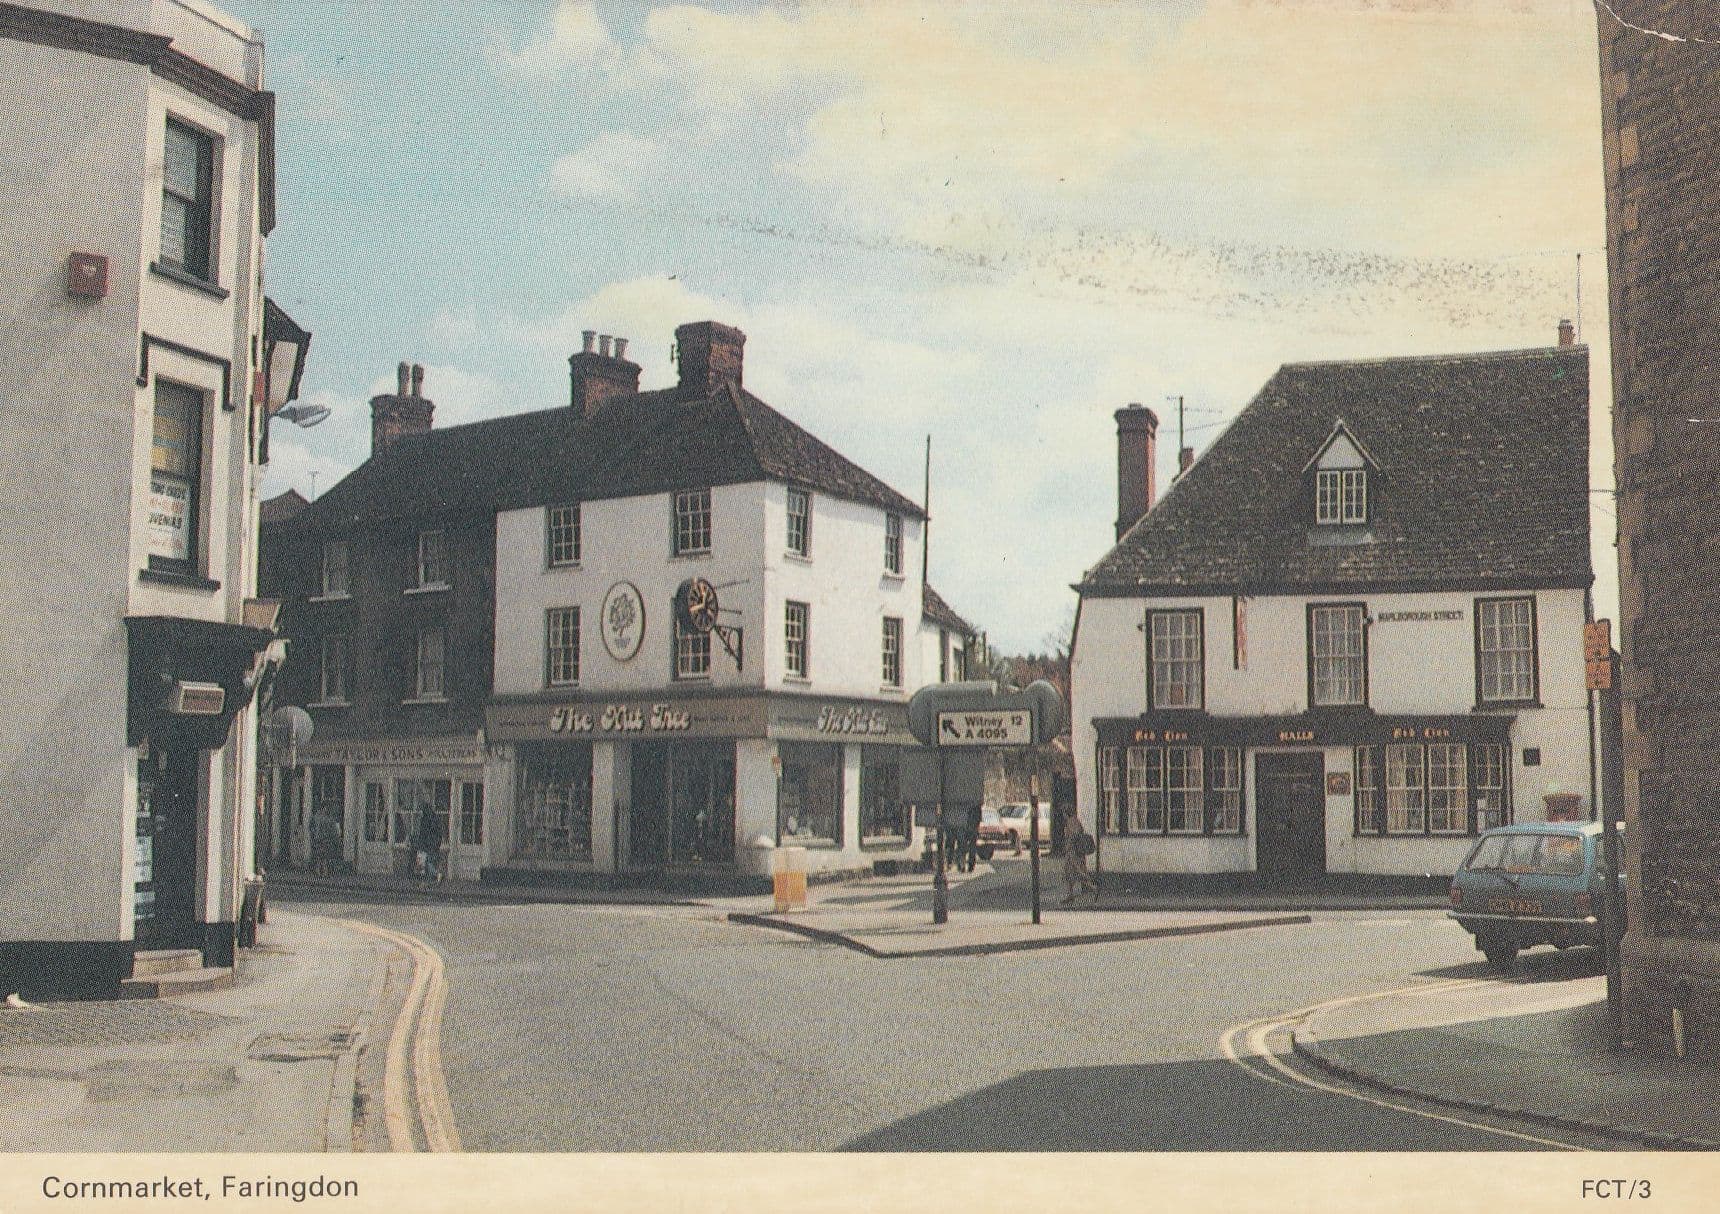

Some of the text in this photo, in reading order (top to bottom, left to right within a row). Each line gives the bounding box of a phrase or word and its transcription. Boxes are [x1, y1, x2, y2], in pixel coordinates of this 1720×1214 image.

[1433, 610, 1464, 620] STREET
[551, 703, 691, 733] The Nut Tree
[965, 715, 1022, 728] Witney 12
[965, 729, 1008, 739] A 4095
[391, 747, 424, 761] SONS
